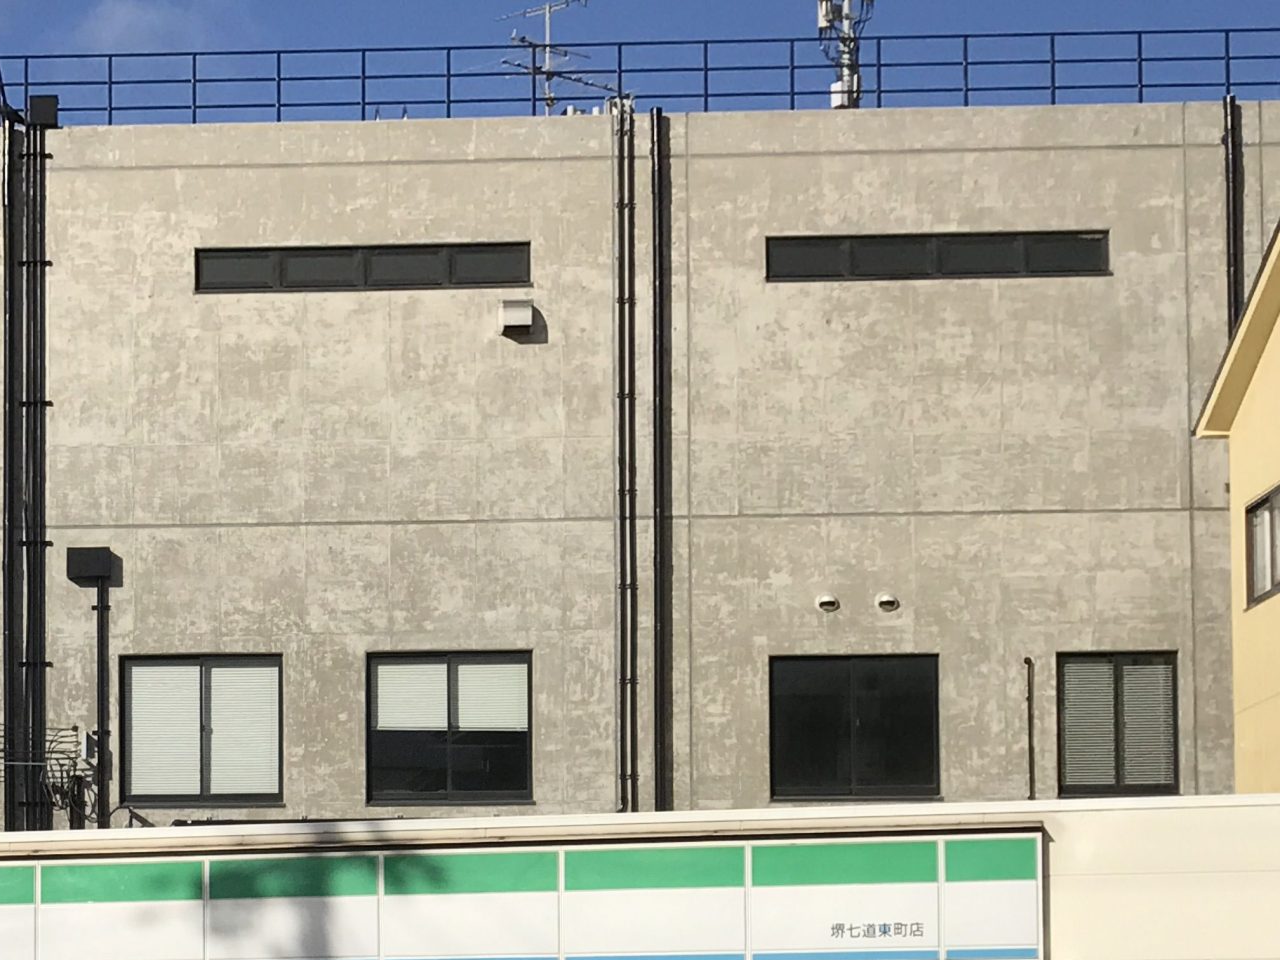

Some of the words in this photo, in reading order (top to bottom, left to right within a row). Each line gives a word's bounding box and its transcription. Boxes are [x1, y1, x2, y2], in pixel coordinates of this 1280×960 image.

[830, 922, 924, 939] 堺七道東町店
